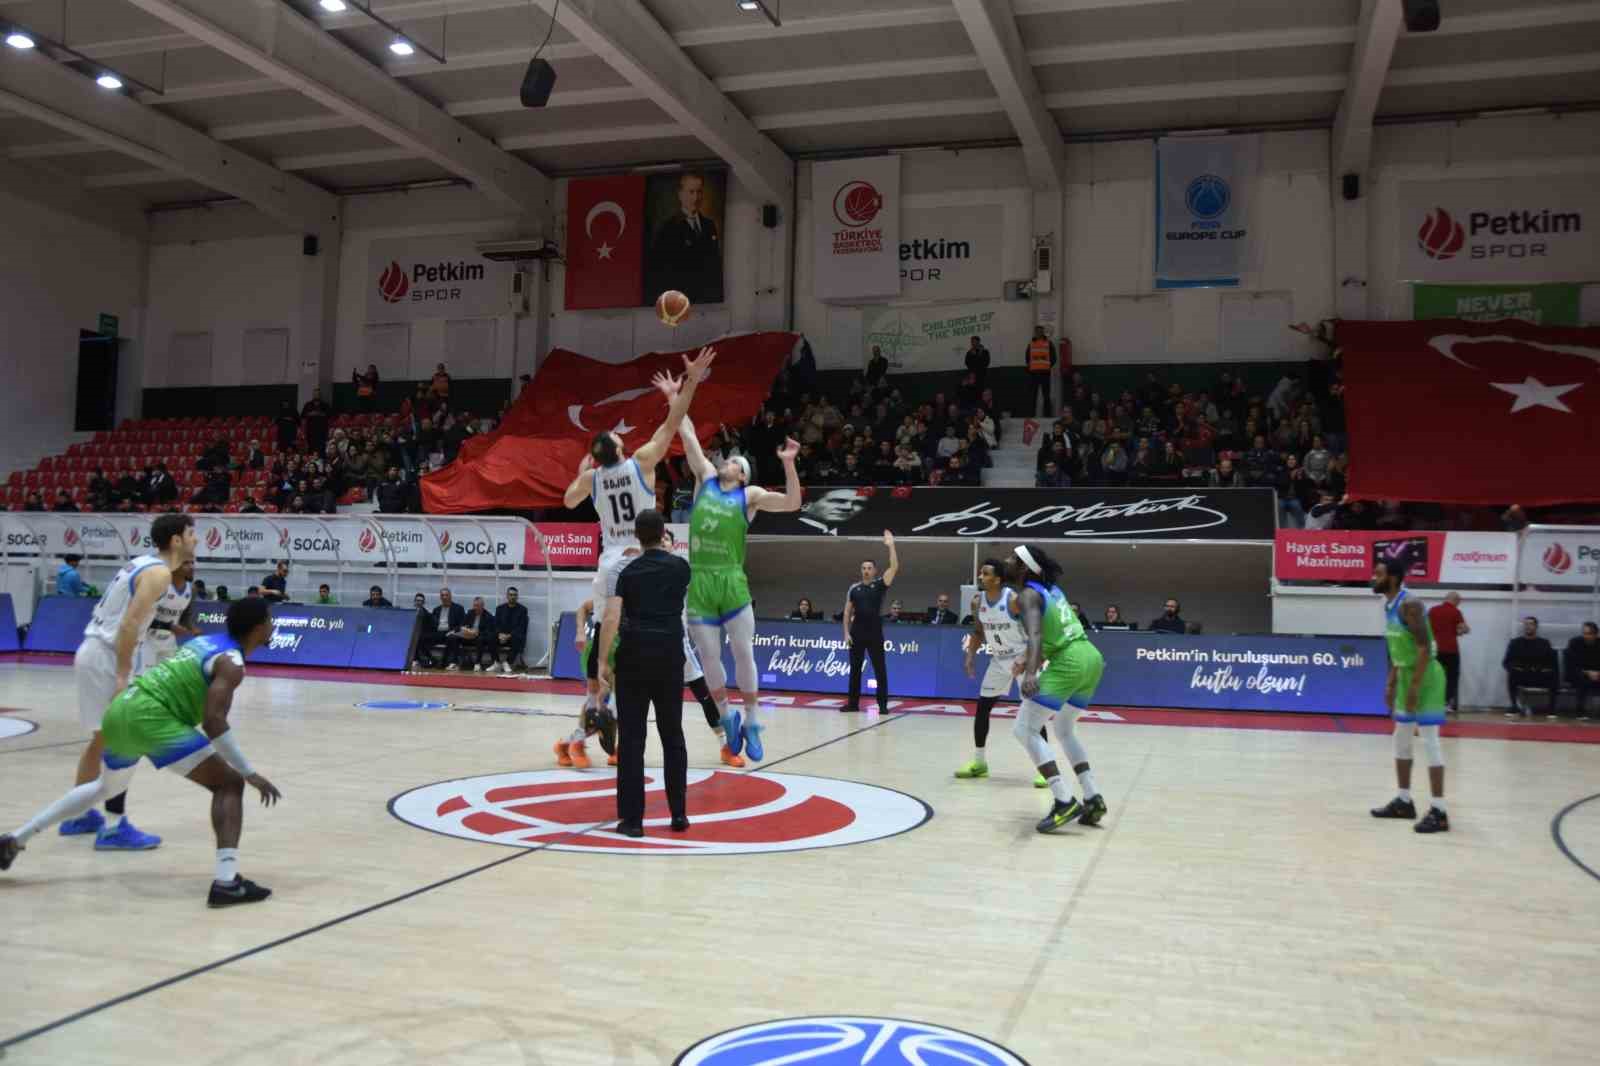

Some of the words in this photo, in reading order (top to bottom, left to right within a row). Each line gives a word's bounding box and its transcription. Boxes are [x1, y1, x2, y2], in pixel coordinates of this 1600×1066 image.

[1469, 210, 1581, 236] Petkim
[1166, 231, 1217, 240] EUROPE
[1220, 229, 1246, 240] CUP
[899, 238, 970, 260] etkim
[1470, 243, 1548, 259] SPOR
[413, 261, 484, 282] Petkim
[899, 268, 941, 281] POR
[411, 288, 461, 301] SPOR
[1456, 291, 1532, 314] NEVER
[921, 313, 977, 334] CHILDREN
[608, 492, 635, 524] 19
[7, 534, 47, 546] SOCAR
[293, 538, 340, 551] SOCAR
[567, 533, 592, 544] Sana
[455, 541, 507, 555] SOCAR
[1286, 542, 1328, 556] Hayat
[1330, 542, 1365, 554] Sana
[1296, 556, 1364, 568] Maximum
[310, 617, 327, 629] 60.
[789, 637, 851, 651] kuruluşu
[768, 649, 814, 675] kutlu
[815, 651, 867, 677] olsu!
[1136, 648, 1208, 662] Petkim'in
[1212, 650, 1309, 666] kuruluşunun
[1312, 652, 1338, 665] 60.
[1341, 653, 1364, 668] yılı
[1190, 665, 1244, 694] kutlu
[1246, 666, 1306, 696] olsun!
